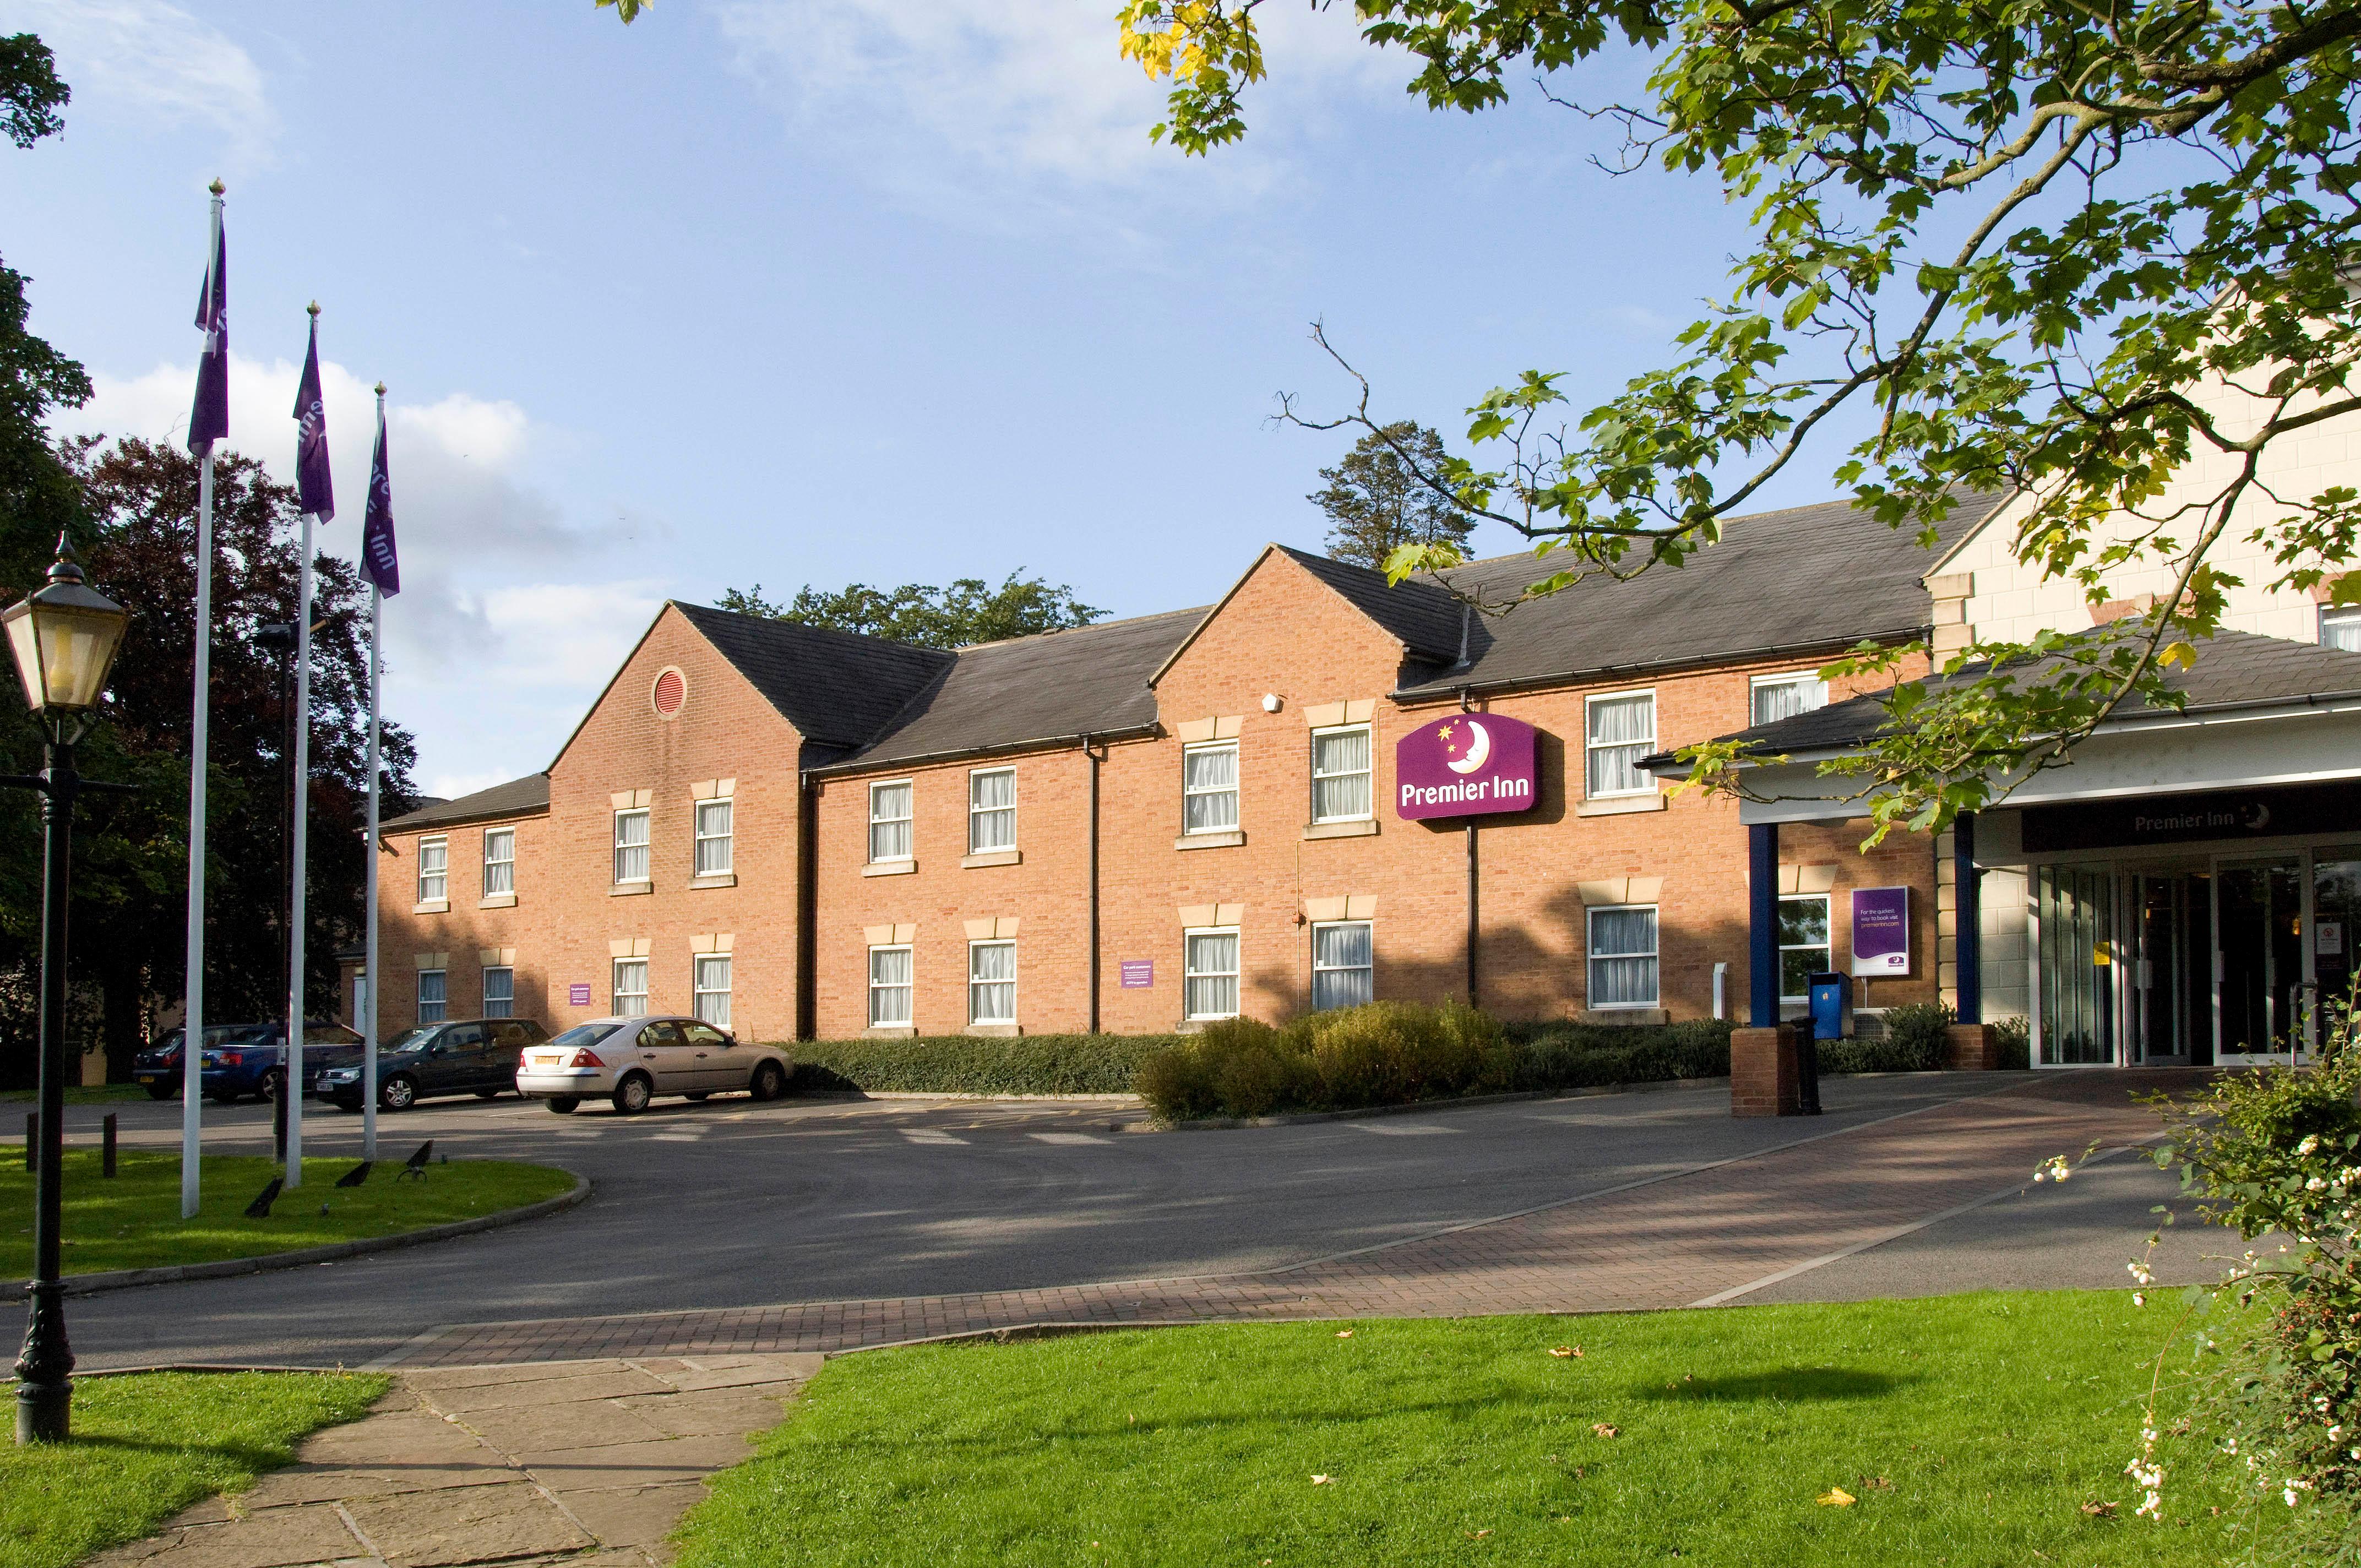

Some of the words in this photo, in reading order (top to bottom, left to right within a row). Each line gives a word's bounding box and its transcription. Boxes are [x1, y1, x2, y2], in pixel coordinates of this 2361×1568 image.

[371, 533, 395, 570] Inn
[1401, 778, 1489, 807] Premier
[1493, 775, 1529, 798] Inn
[2135, 813, 2203, 831] Premier
[2207, 812, 2235, 827] Inn
